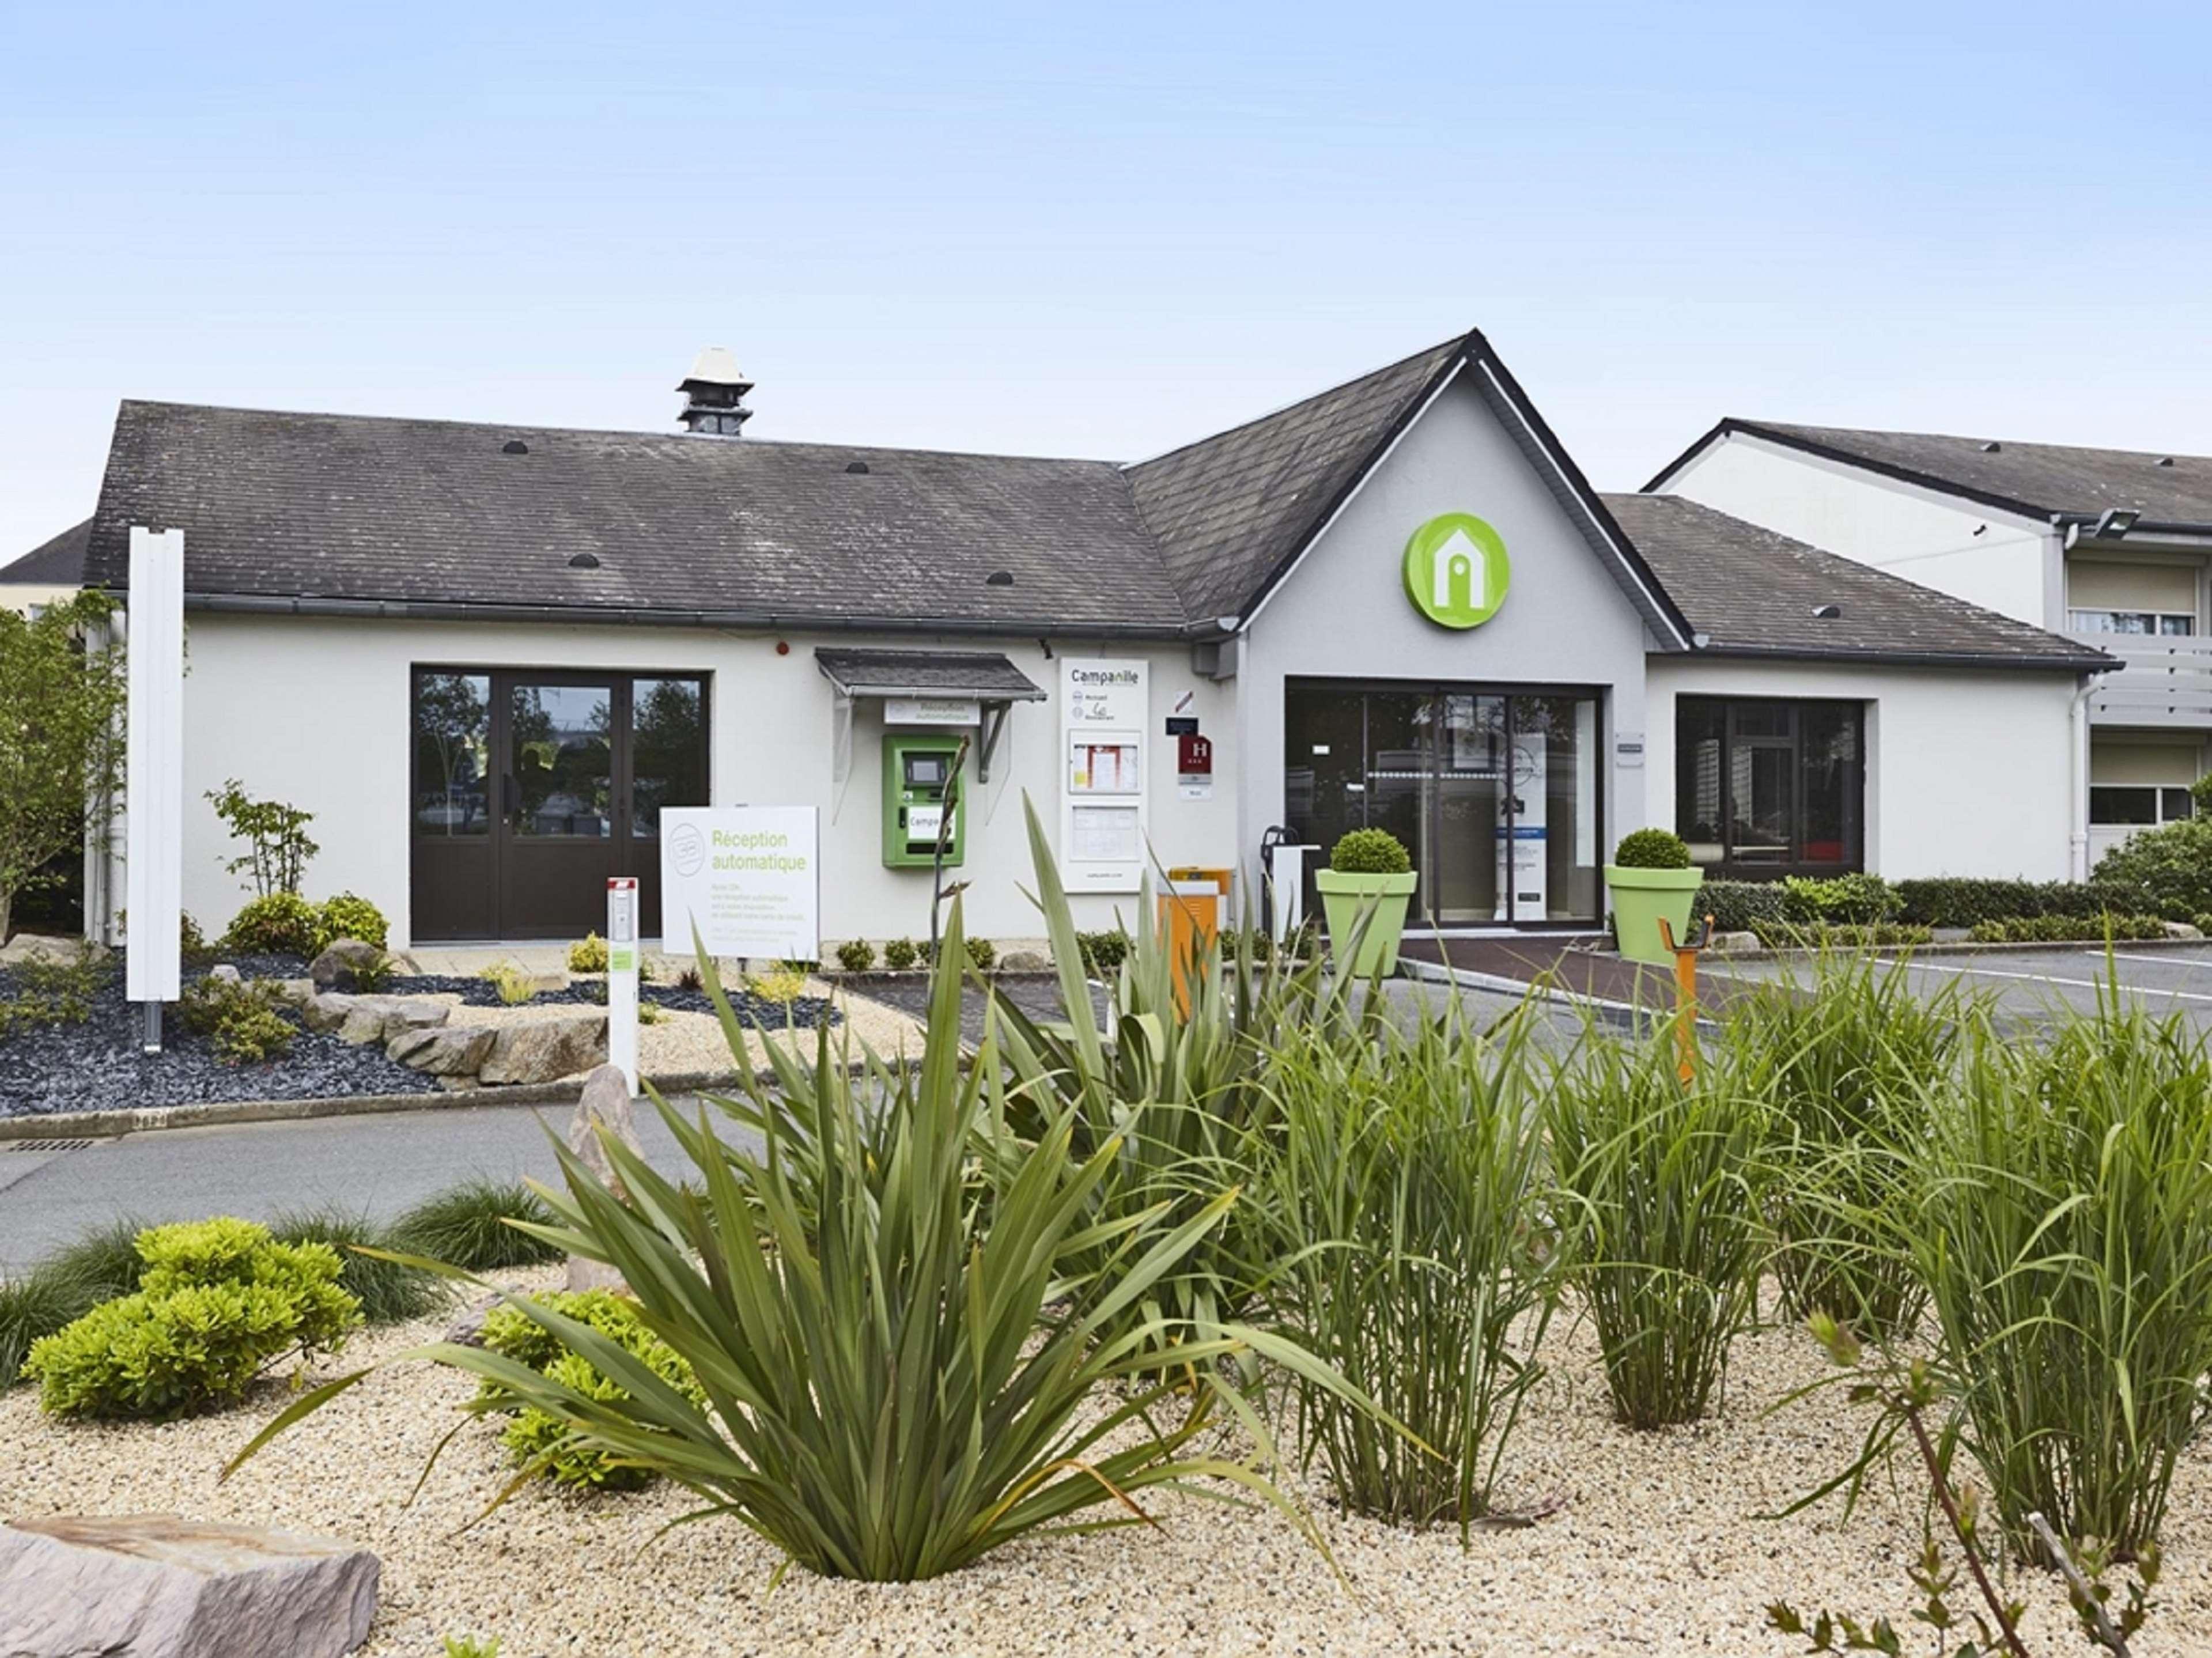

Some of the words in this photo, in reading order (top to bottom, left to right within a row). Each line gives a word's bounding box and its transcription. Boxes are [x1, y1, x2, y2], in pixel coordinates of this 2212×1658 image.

[1193, 743, 1208, 757] H
[712, 830, 787, 849] Réception
[712, 854, 806, 873] automatique
